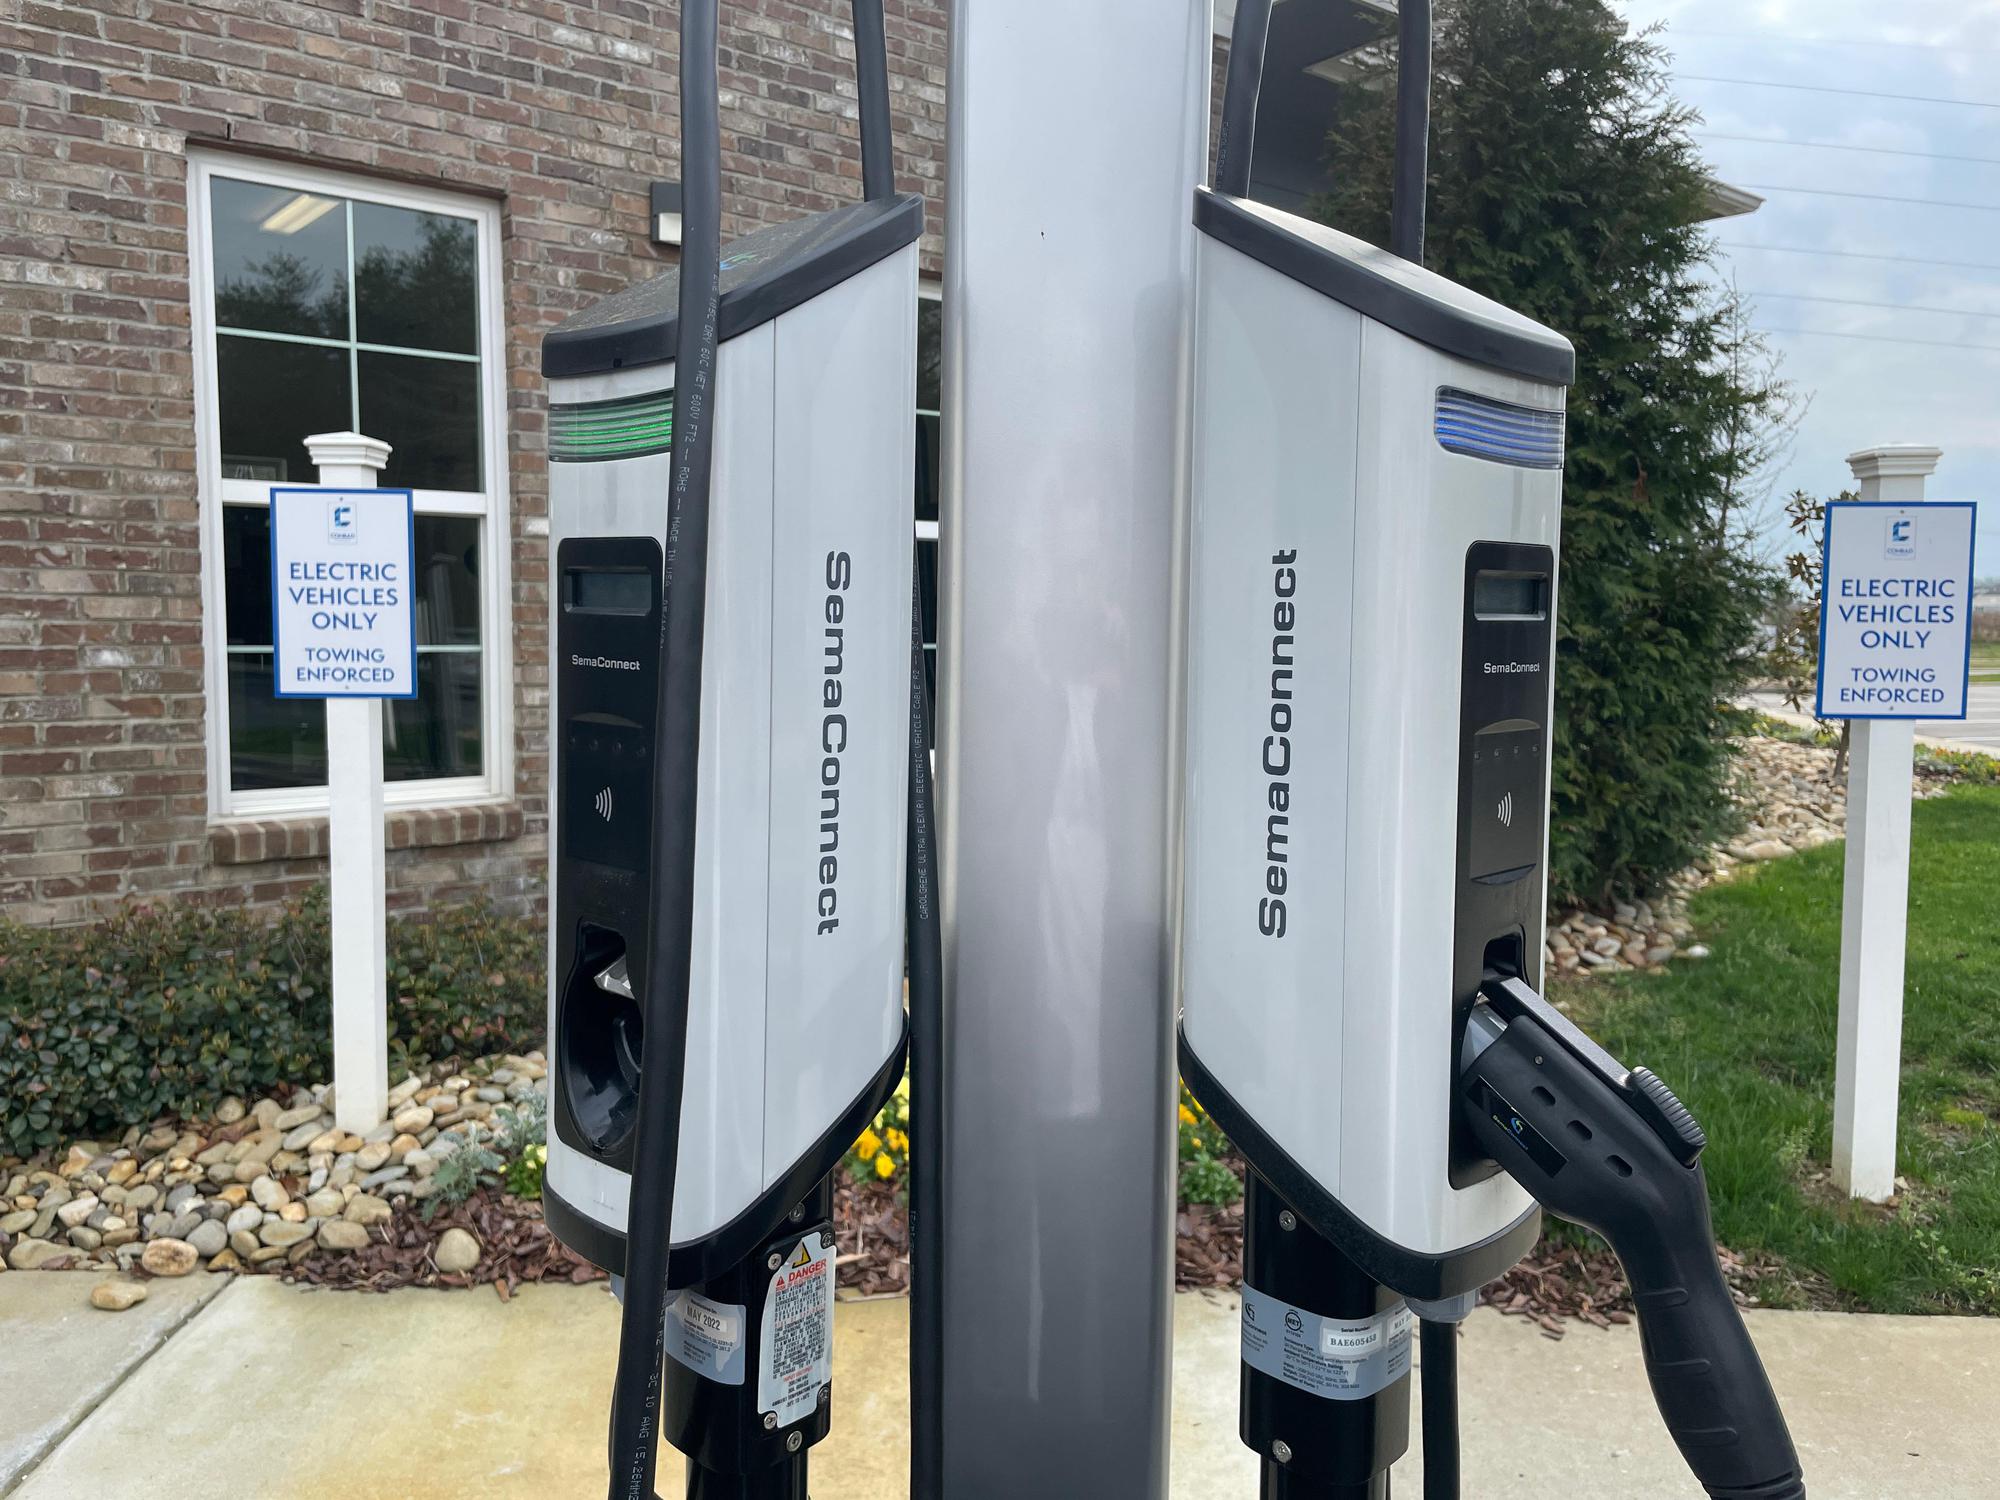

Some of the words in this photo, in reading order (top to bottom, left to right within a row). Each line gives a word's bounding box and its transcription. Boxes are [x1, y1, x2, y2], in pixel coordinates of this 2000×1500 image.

[702, 324, 714, 344] DRY
[700, 347, 711, 367] 60C
[690, 394, 701, 420] 600V
[684, 423, 698, 443] FT2
[289, 562, 397, 581] ELECTRIC
[288, 587, 399, 606] VEHICLES
[1841, 579, 1956, 598] ELECTRIC
[311, 612, 378, 630] ONLY
[1838, 605, 1955, 623] VEHICLES
[1860, 630, 1931, 648] ONLY
[304, 648, 385, 663] TOWING
[571, 654, 640, 670] SemaConnect
[296, 667, 395, 683] ENFORCED
[1483, 662, 1540, 674] SemaConnect
[1851, 668, 1936, 683] TOWING
[913, 684, 921, 709] CABLE
[1840, 687, 1945, 703] ENFORCED
[913, 713, 922, 749] VEHICLE
[817, 550, 851, 936] SemaConnect
[1258, 548, 1298, 939] SemaConnect
[914, 753, 924, 794] ELECTRIC
[788, 1258, 826, 1282] DANGER
[687, 1305, 702, 1322] MAY
[703, 1314, 721, 1331] 2022
[645, 1395, 656, 1409] 10
[639, 1416, 651, 1439] AWG
